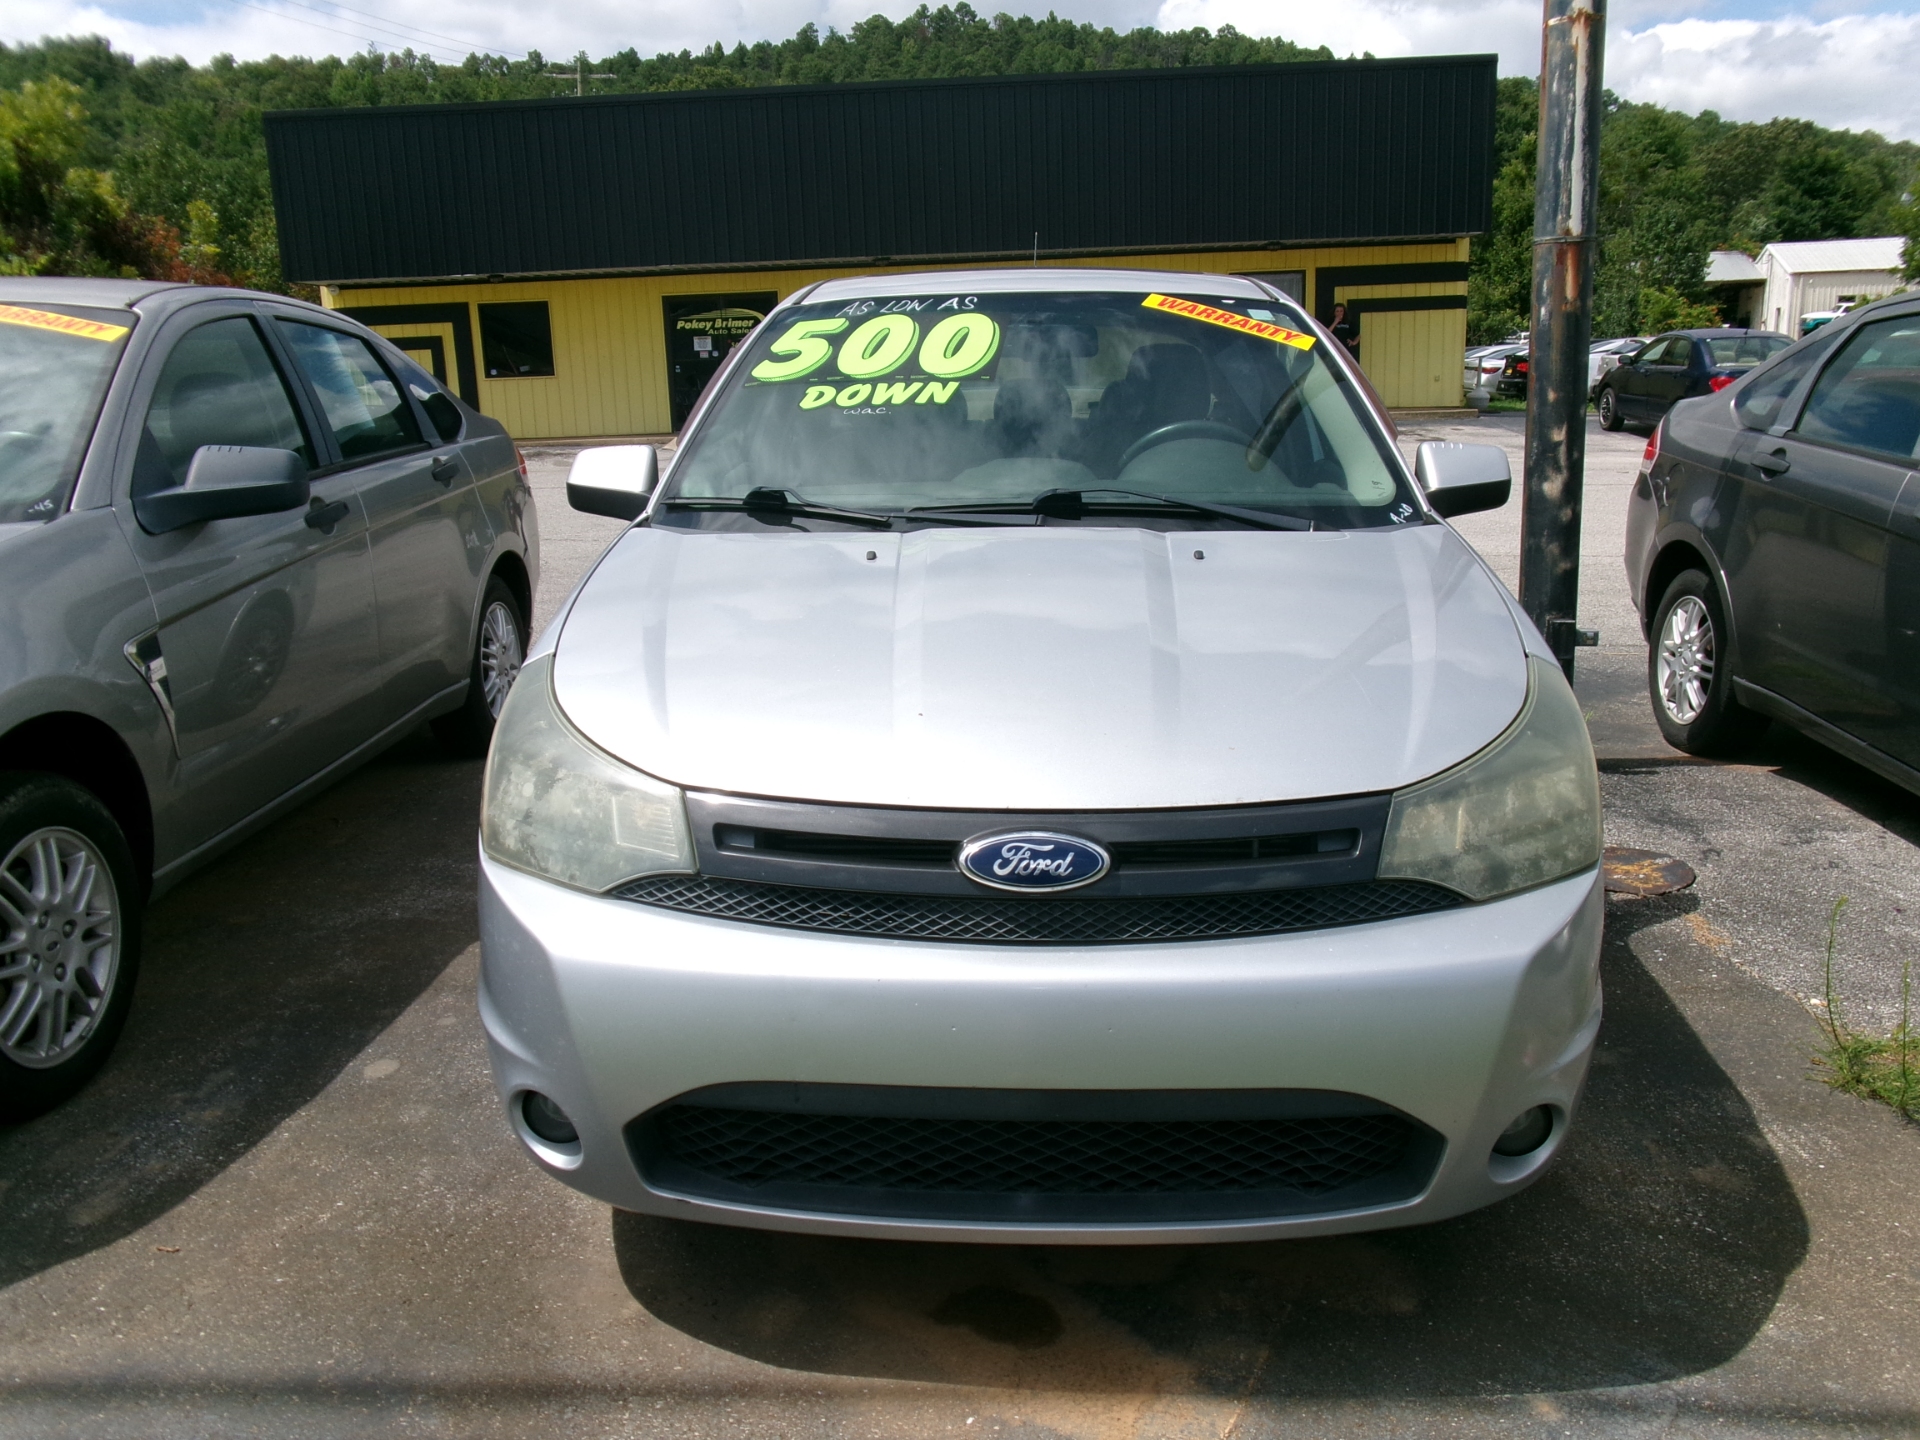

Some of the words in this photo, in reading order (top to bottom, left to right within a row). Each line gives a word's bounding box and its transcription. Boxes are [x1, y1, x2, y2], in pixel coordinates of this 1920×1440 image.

[0, 304, 117, 335] ARRANTY
[835, 301, 874, 317] AS
[880, 299, 934, 313] LOW
[937, 296, 978, 310] AS
[1157, 296, 1304, 342] WARRANTY
[676, 319, 713, 331] Pokey
[714, 318, 754, 328] Brimer
[751, 313, 1000, 382] 500
[799, 381, 960, 410] DOWN
[993, 842, 1075, 876] Ford
